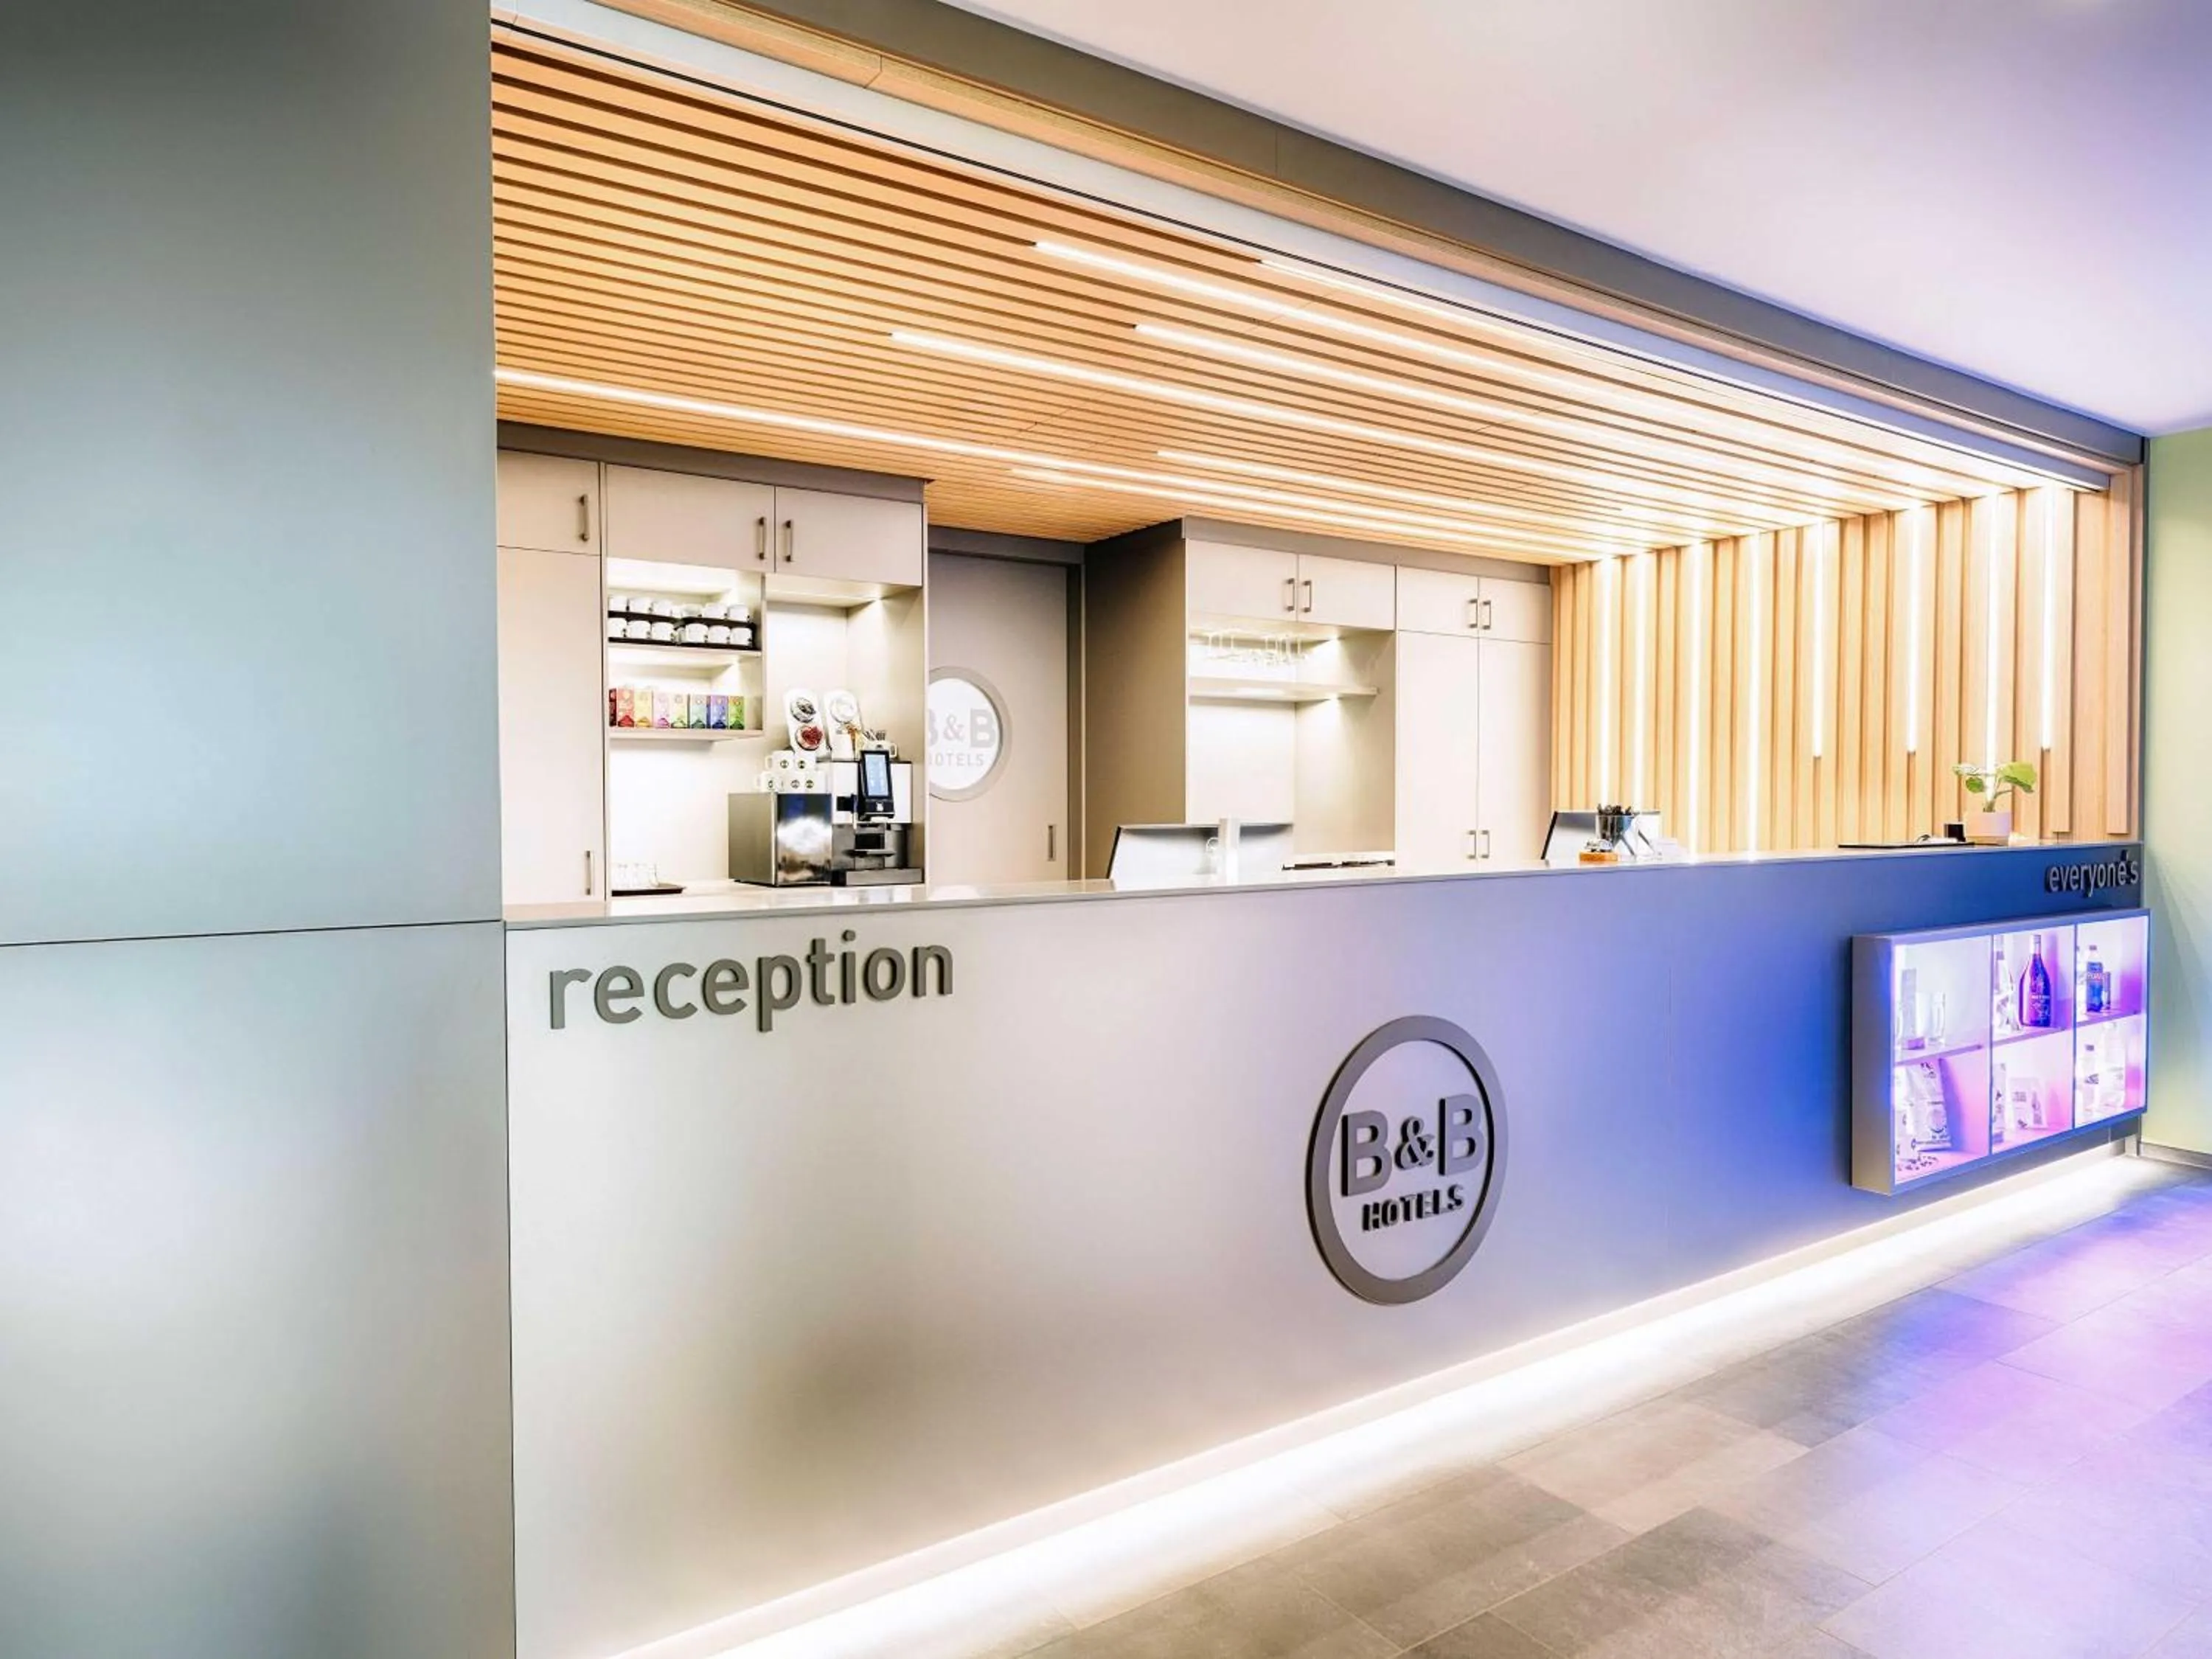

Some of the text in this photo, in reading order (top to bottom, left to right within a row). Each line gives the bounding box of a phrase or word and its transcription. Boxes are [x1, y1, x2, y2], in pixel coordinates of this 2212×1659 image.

[929, 752, 984, 767] OTELS
[2045, 849, 2139, 898] everyone's
[549, 929, 953, 1033] reception
[1340, 1093, 1485, 1197] B&B
[1361, 1183, 1465, 1232] HOTELS
